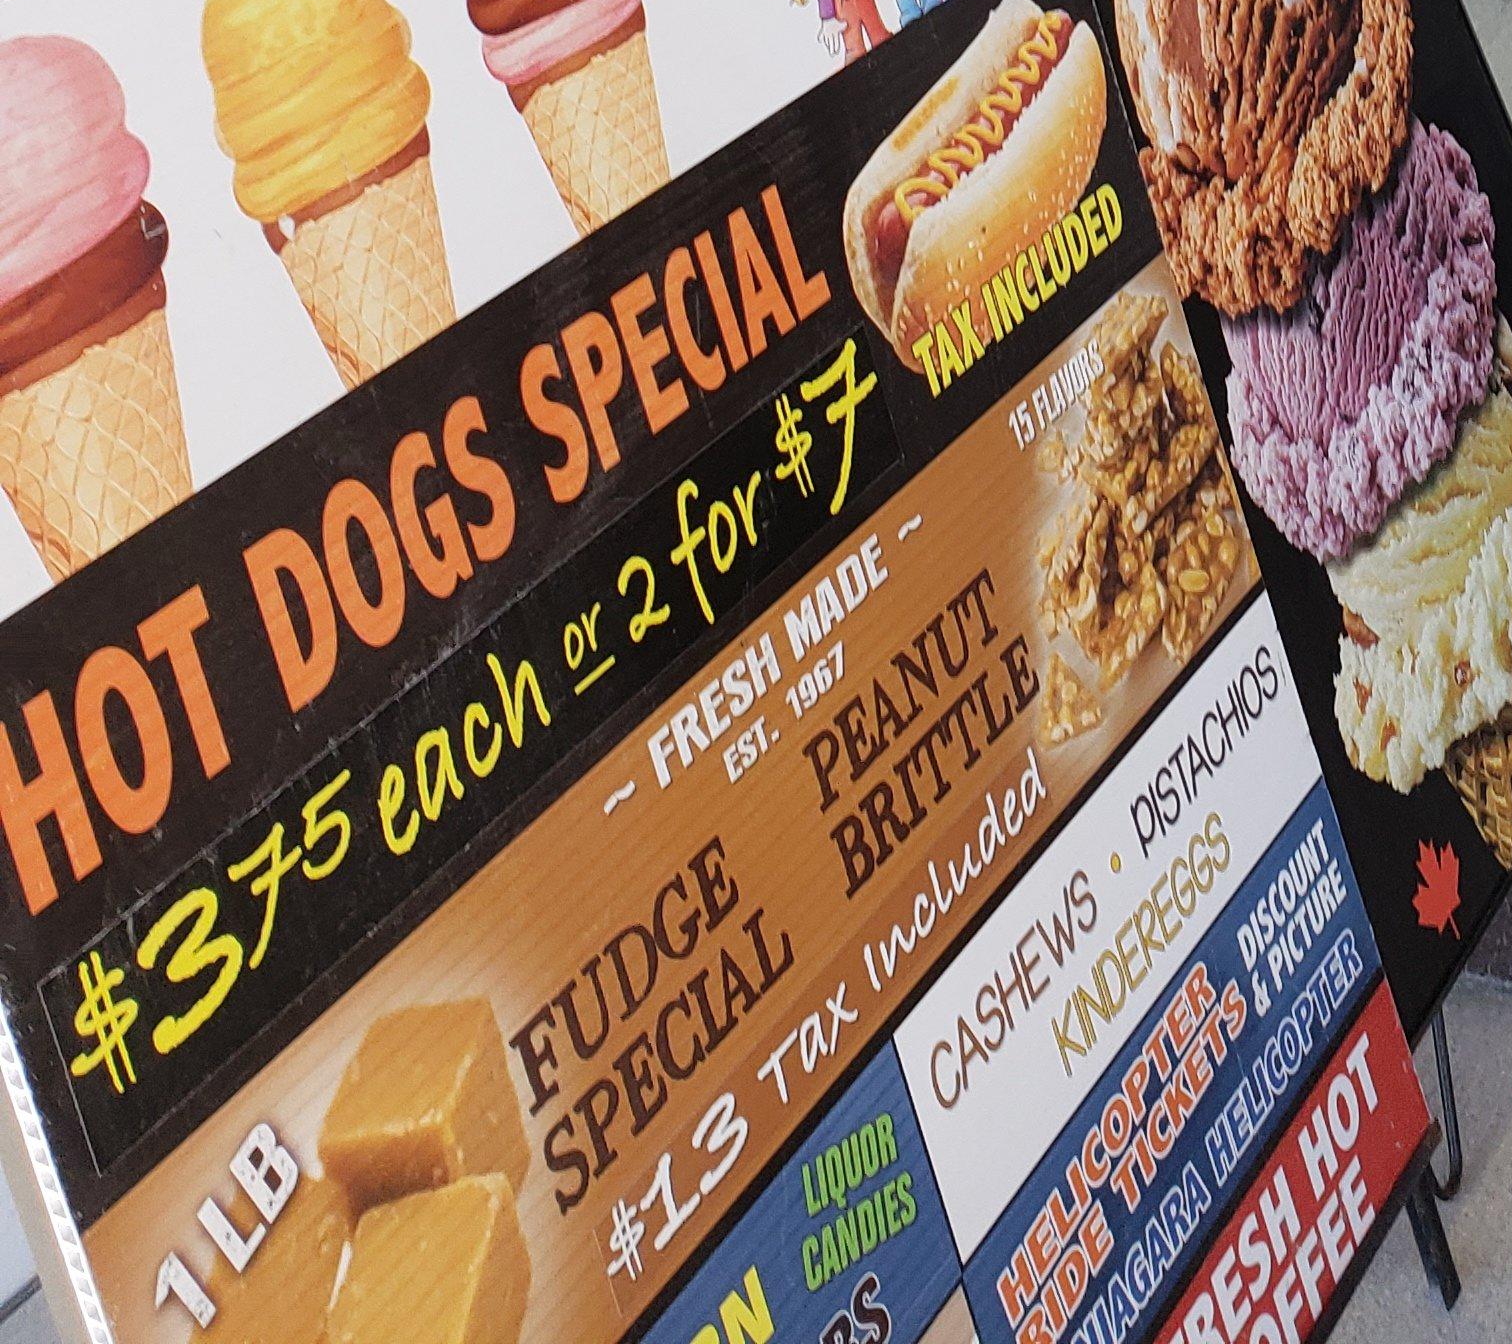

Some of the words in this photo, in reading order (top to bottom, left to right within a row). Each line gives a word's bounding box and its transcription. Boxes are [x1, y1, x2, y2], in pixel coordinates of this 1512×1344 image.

[911, 297, 988, 399] TAX
[987, 182, 1125, 345] INCLUDED
[1008, 399, 1037, 452] 15
[1031, 336, 1106, 431] FLAVORS
[0, 584, 231, 916] HOT
[242, 394, 517, 712] DOGS
[520, 183, 832, 504] SPECIAL
[378, 652, 553, 855] each
[563, 602, 616, 670] or
[617, 554, 670, 644] 2
[670, 475, 763, 625] for
[775, 337, 879, 515] $7
[647, 634, 783, 790] FRESH
[783, 532, 890, 646] MADE
[722, 727, 783, 785] EST.
[784, 642, 847, 722] 1967
[801, 567, 1004, 812] PEANUT
[829, 634, 1040, 900] BRITTLE
[509, 834, 740, 1118] FUDGE
[929, 864, 1099, 1110] CASHEWS
[1130, 645, 1279, 859] PISTACHIOS
[1051, 811, 1233, 1078] KINDEREGGS
[1236, 817, 1334, 968] DISCOUNT
[1252, 976, 1271, 1018] &
[1267, 860, 1348, 997] PICTURE
[541, 905, 796, 1217] SPECIAL
[605, 1089, 750, 1282] $13
[756, 979, 860, 1107] Tax
[862, 745, 1048, 994] Included
[1069, 1160, 1212, 1344] NIAGARA
[1203, 926, 1365, 1188] HELICOPTER
[1299, 1038, 1380, 1203] HOT
[154, 1251, 217, 1330] 1
[196, 1122, 300, 1275] LB
[802, 1112, 898, 1218] LIQUOR
[802, 1170, 919, 1293] CANDIES
[996, 961, 1217, 1329] HELICOPTER
[1015, 1199, 1116, 1344] RIDE
[1109, 979, 1247, 1213] TICKETS
[1250, 1154, 1376, 1344] OFFEE
